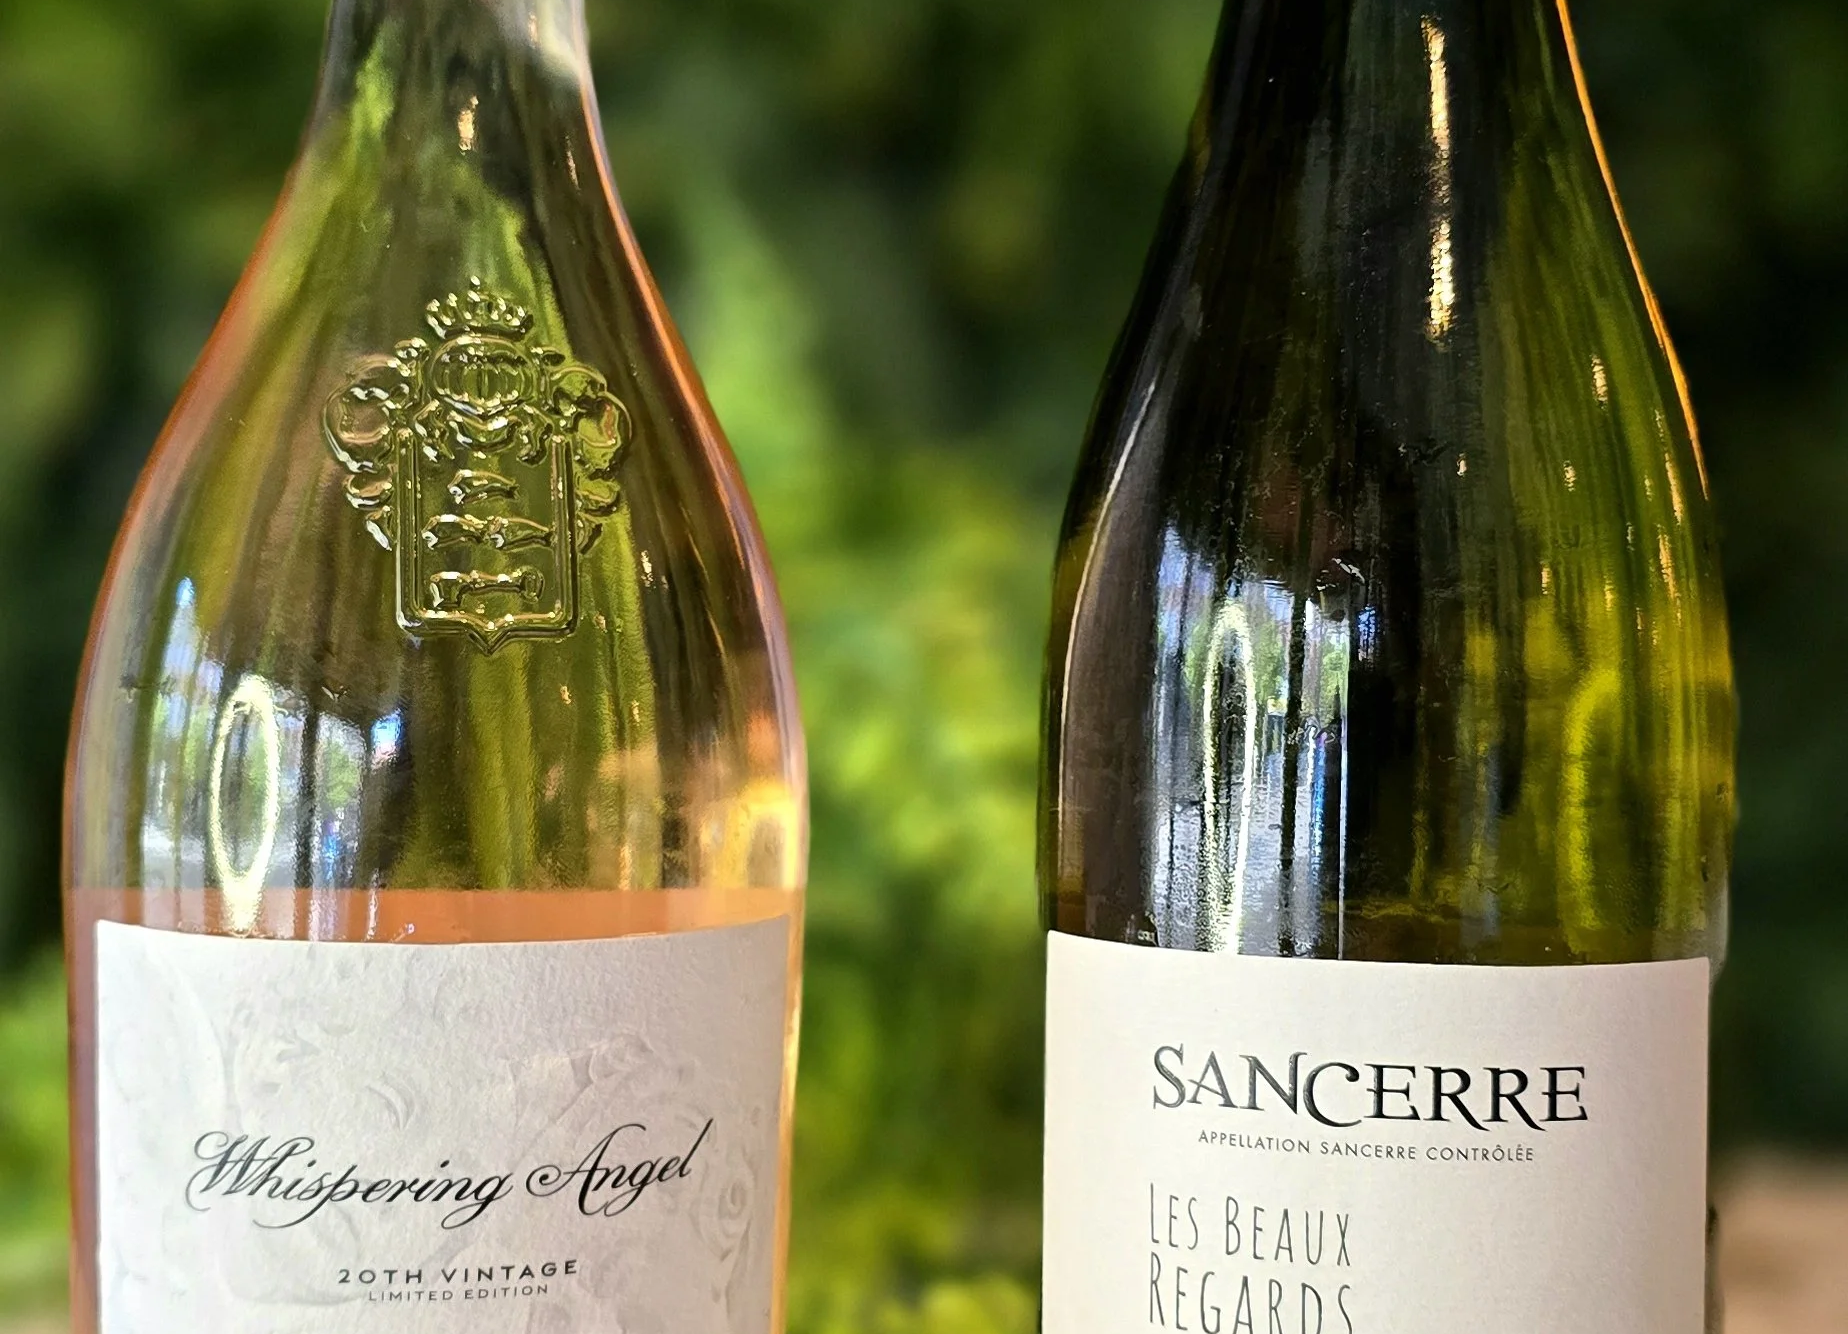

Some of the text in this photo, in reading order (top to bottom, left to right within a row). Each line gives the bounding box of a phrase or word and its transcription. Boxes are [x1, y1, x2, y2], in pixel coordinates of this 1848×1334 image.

[1152, 1042, 1589, 1132] SANCERRE
[184, 1117, 715, 1230] Whispering Angel
[1198, 1129, 1535, 1162] APPELLATION SANCERRE CONTRÔLÉE
[1149, 1182, 1351, 1267] LES BEAUX
[338, 1259, 579, 1285] 20TH VINTAGE
[367, 1283, 549, 1303] LIMITED EDITION
